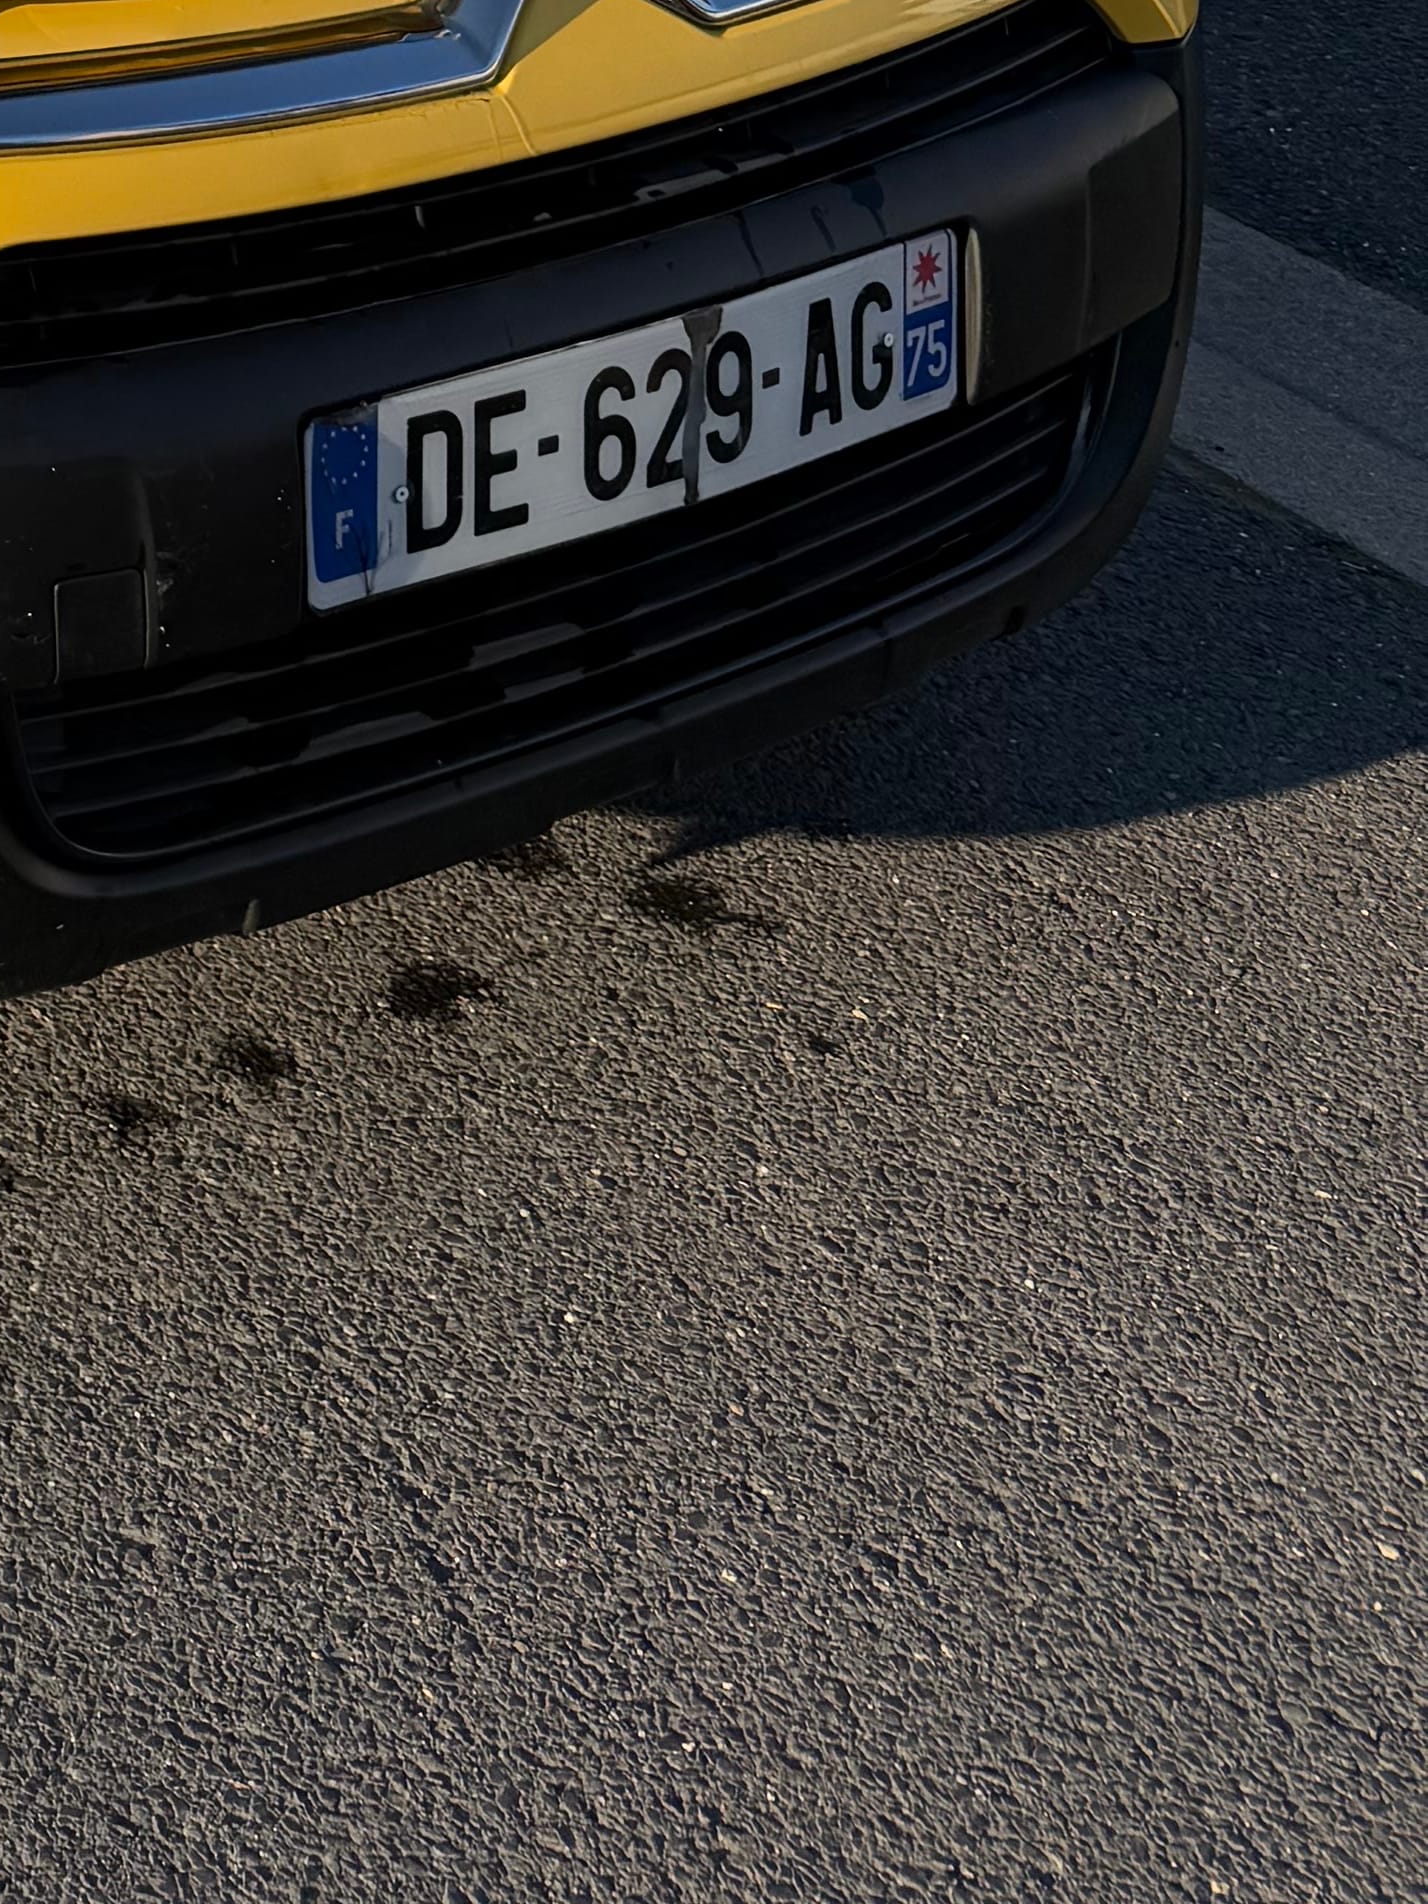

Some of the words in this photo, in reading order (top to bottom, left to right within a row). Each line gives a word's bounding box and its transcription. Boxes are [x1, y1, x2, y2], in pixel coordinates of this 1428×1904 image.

[906, 319, 948, 388] 75
[406, 281, 893, 554] DE-629-AG
[335, 508, 354, 551] F
